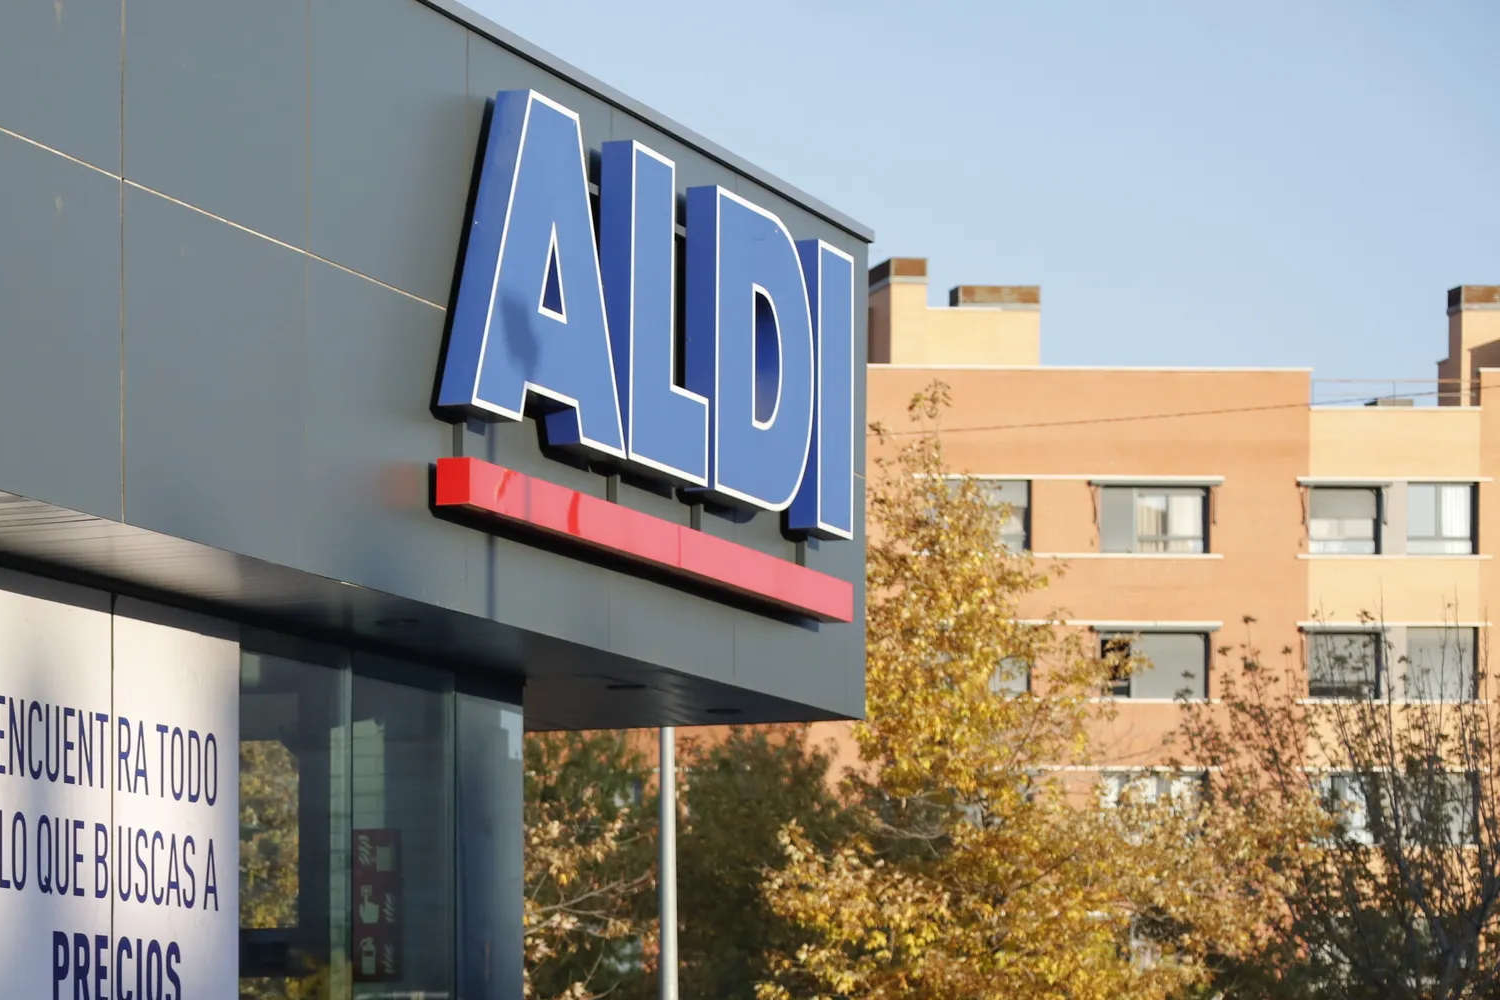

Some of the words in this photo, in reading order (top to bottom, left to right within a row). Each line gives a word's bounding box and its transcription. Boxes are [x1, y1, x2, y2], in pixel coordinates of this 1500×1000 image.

[438, 88, 854, 540] ALDI
[156, 723, 217, 806] TODO
[37, 815, 85, 897] QUE
[95, 823, 196, 909] BUSCAS
[203, 838, 219, 911] A
